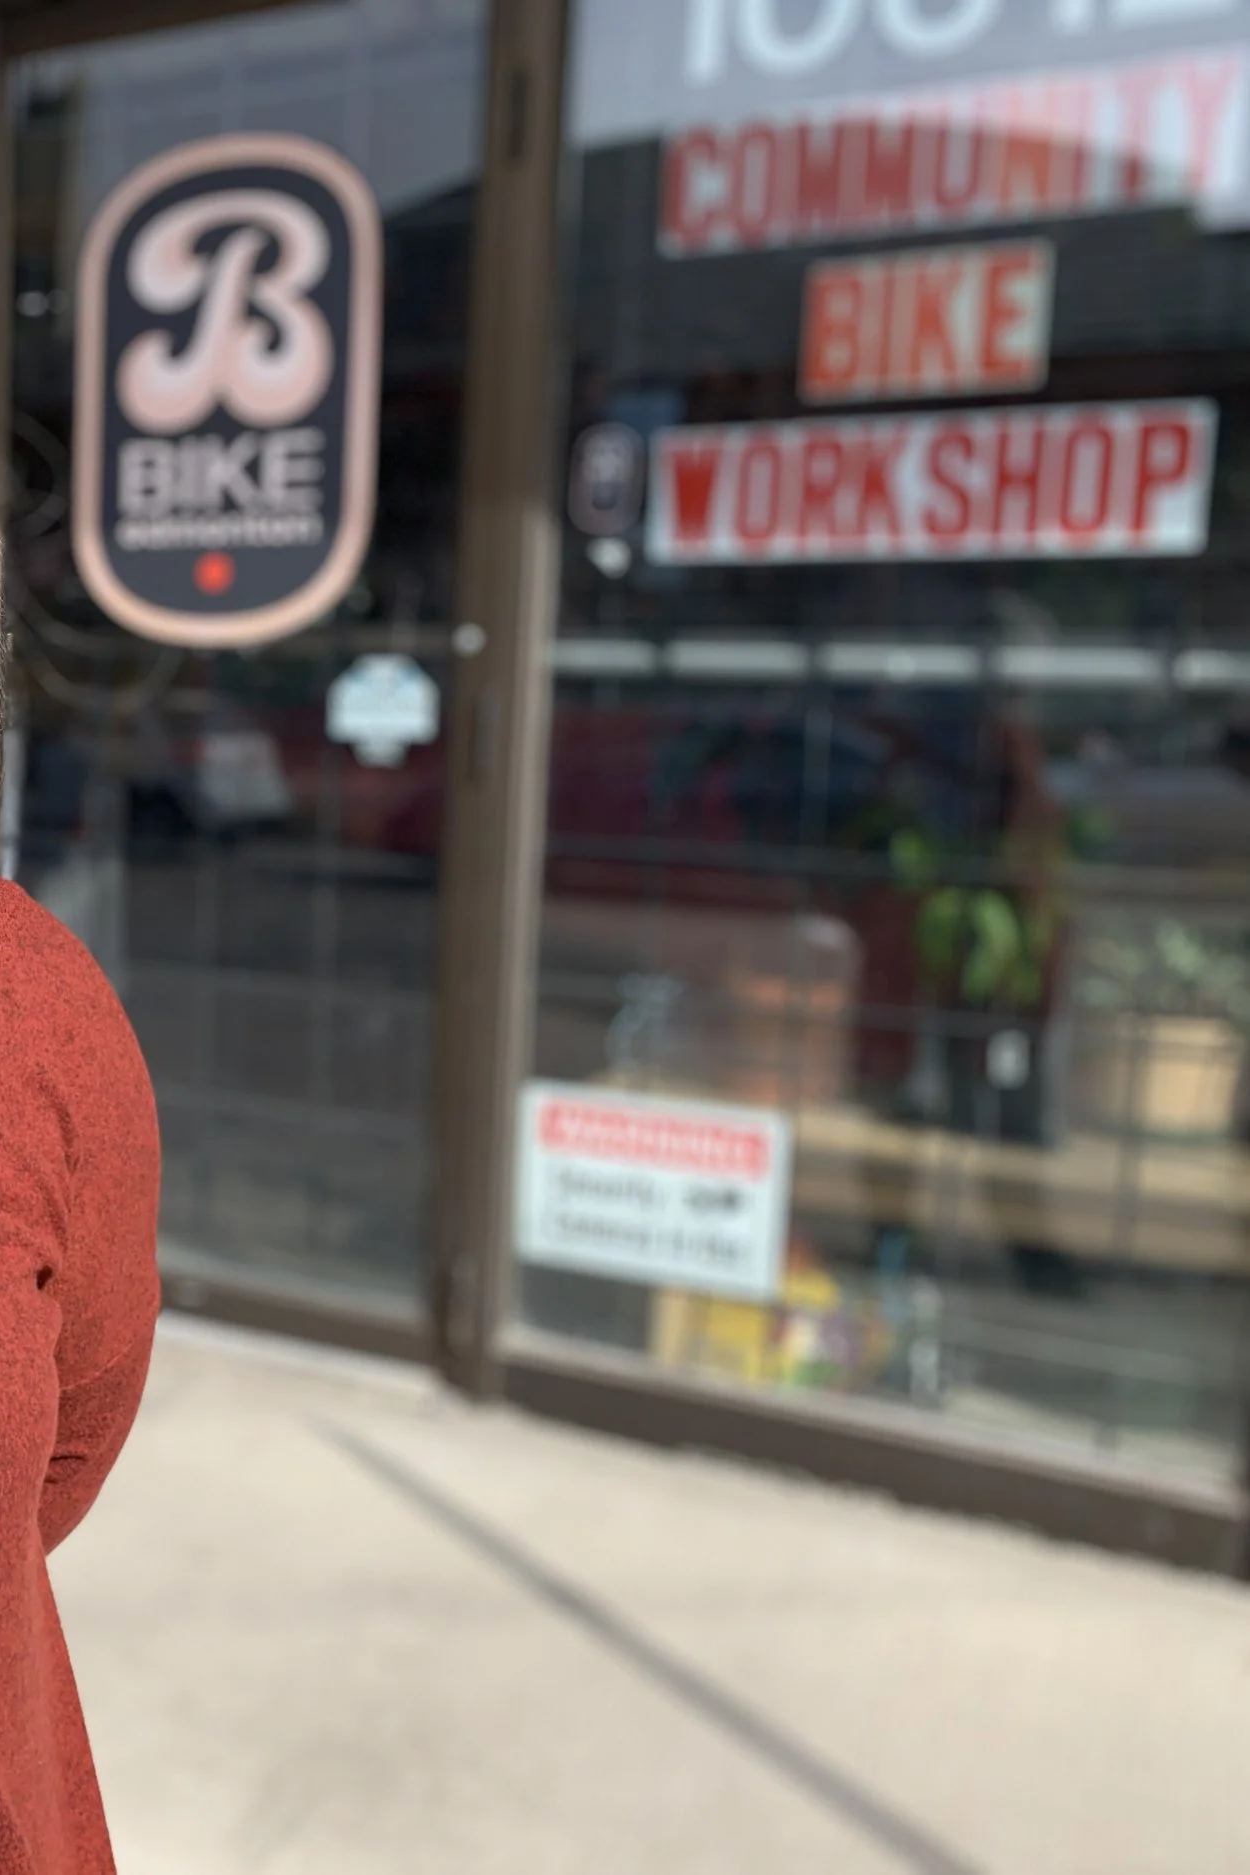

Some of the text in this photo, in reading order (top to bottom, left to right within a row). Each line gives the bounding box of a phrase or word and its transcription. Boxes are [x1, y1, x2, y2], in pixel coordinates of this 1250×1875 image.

[660, 52, 1242, 250] COMMUNITY
[800, 246, 1040, 396] BIKE
[117, 428, 326, 514] BIKE
[661, 414, 1194, 557] WORKSHOP
